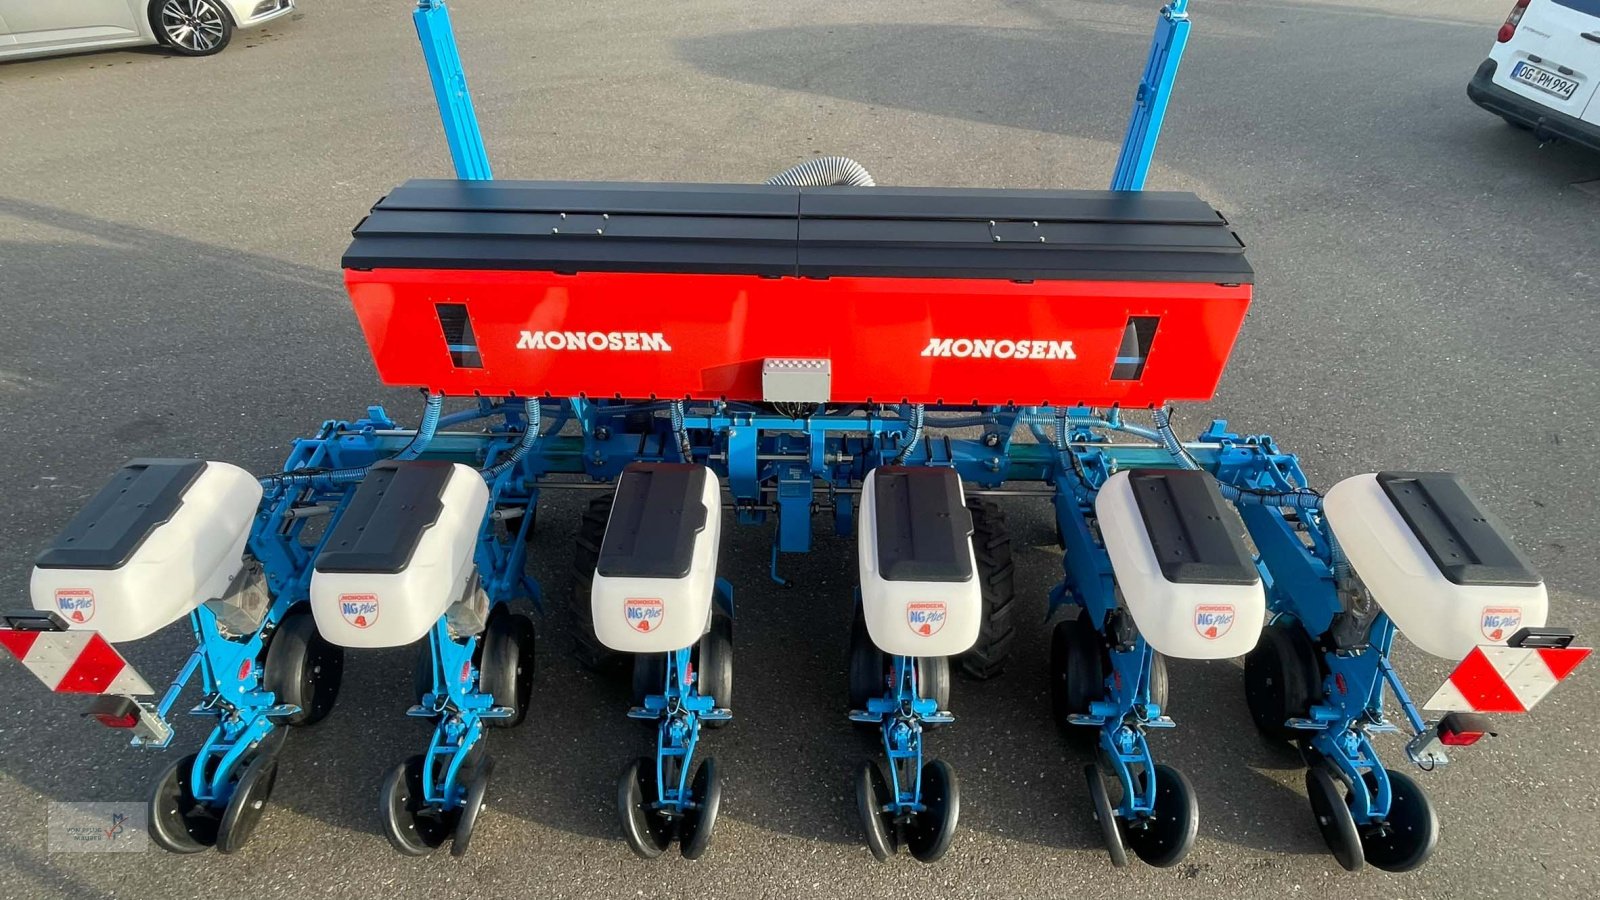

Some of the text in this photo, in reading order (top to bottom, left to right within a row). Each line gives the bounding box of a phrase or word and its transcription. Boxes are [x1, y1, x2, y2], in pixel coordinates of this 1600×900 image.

[1519, 66, 1574, 95] OG PM 994
[516, 330, 672, 352] MONOSEM
[920, 338, 1077, 360] MONOSEM
[59, 598, 74, 609] NG
[343, 603, 358, 614] NG
[72, 610, 84, 622] 4
[627, 607, 642, 618] NG
[910, 611, 925, 622] NG
[355, 615, 367, 627] 4
[1198, 614, 1213, 625] NG
[1484, 616, 1499, 627] NG
[637, 620, 650, 631] 4
[918, 623, 931, 635] 4
[1204, 626, 1217, 638] 4
[1490, 629, 1503, 640] 4
